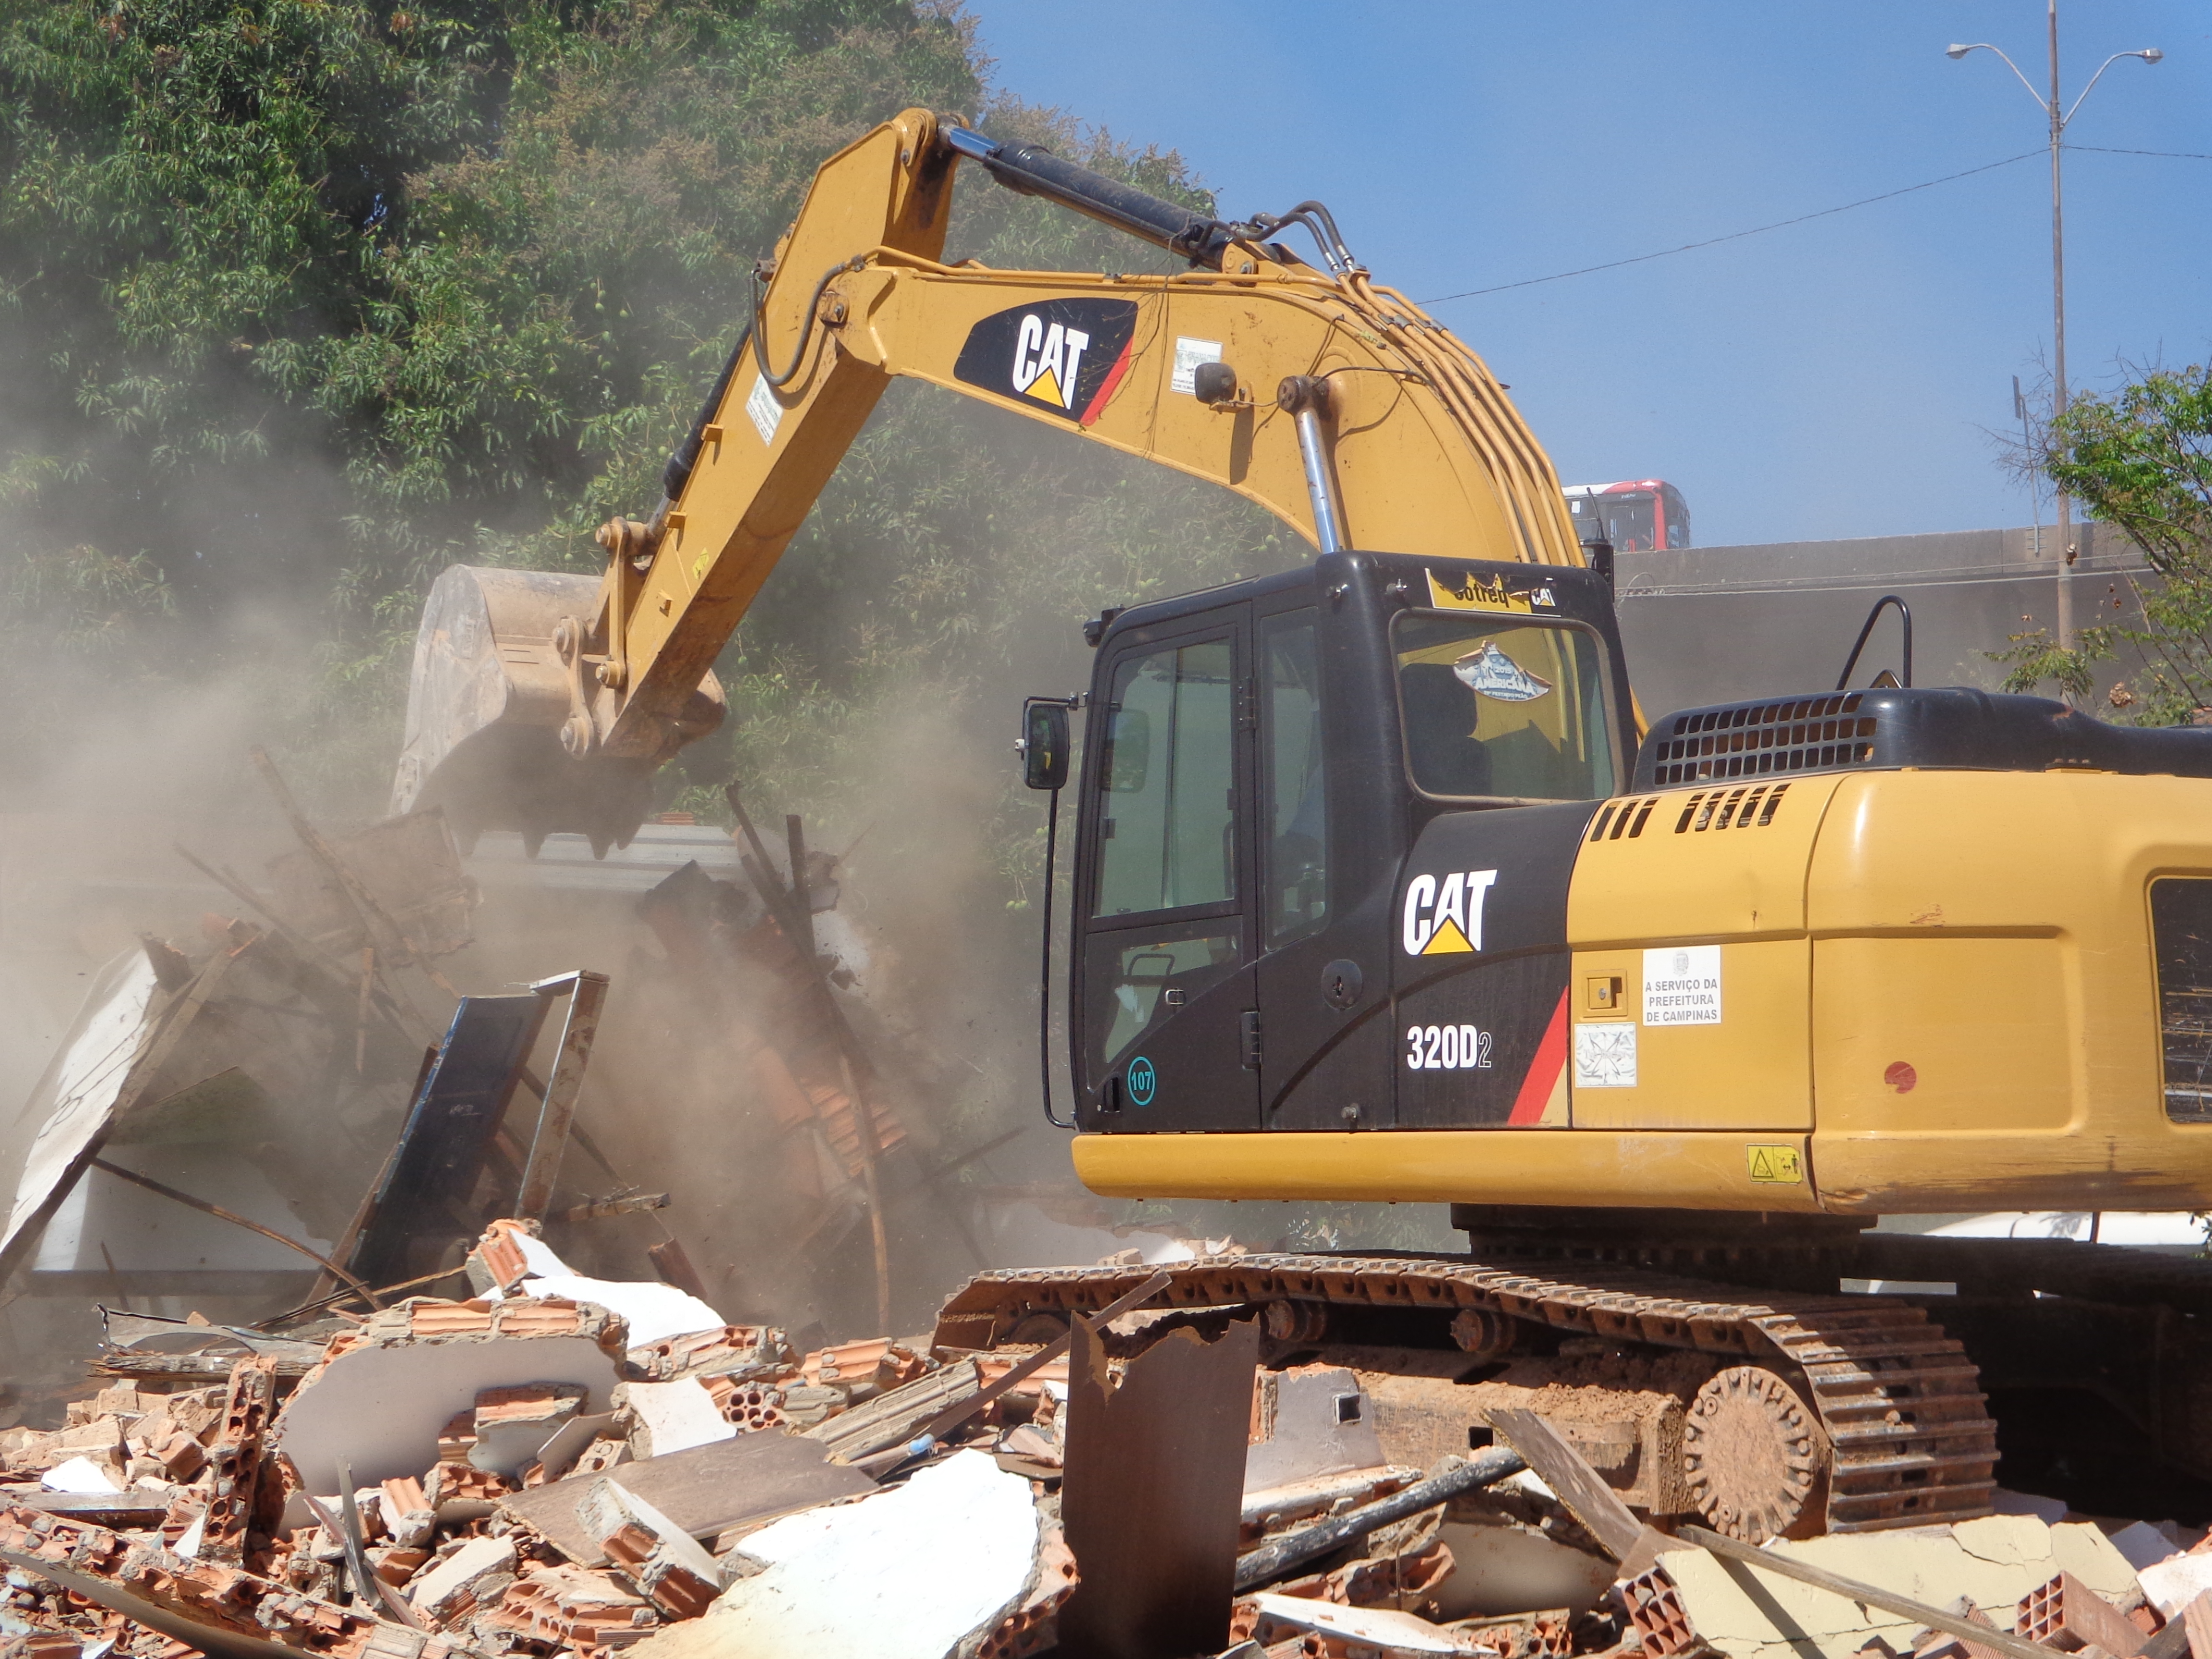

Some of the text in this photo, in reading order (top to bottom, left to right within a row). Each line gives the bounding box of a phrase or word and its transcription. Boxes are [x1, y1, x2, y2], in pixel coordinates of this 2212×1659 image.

[1012, 314, 1090, 410] CAT
[1403, 869, 1498, 955] CAT
[1645, 978, 1718, 993] A SERVIÇO DA
[1649, 994, 1714, 1007] PREFEITURA
[1647, 1009, 1717, 1022] DE CAMPINAS
[1407, 1024, 1492, 1070] 320D2
[1131, 1071, 1152, 1090] 107
